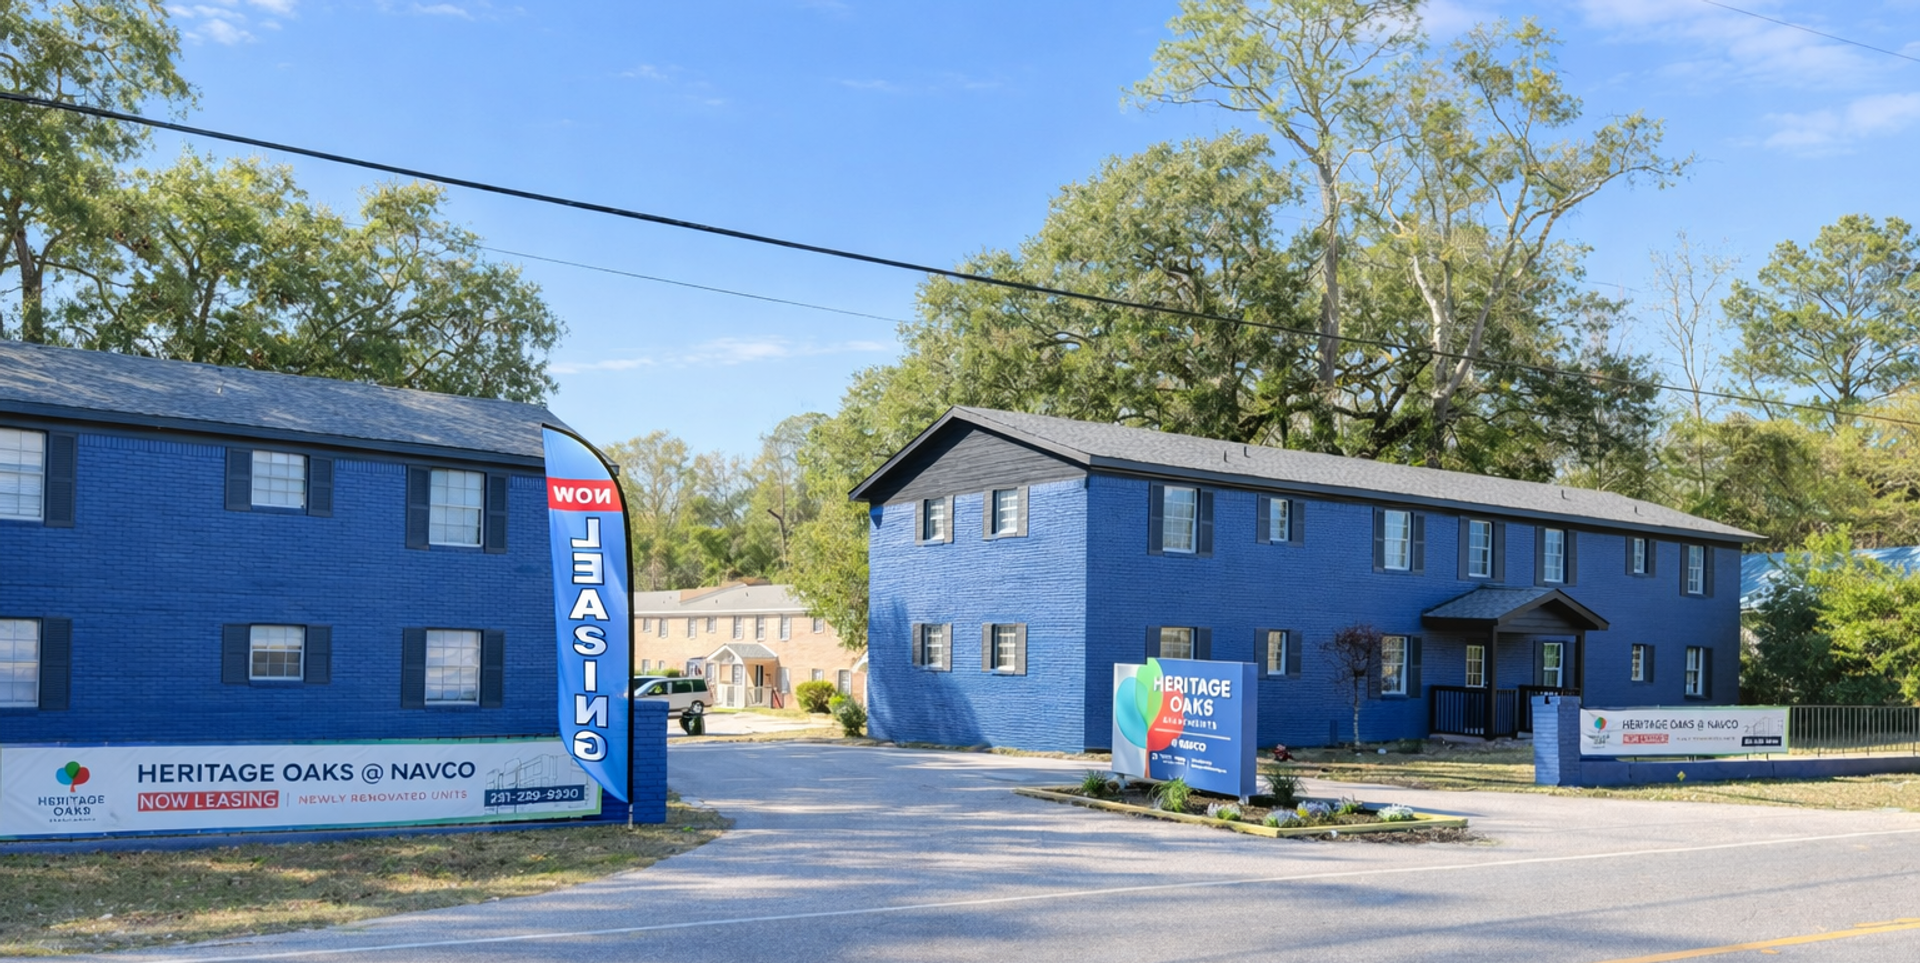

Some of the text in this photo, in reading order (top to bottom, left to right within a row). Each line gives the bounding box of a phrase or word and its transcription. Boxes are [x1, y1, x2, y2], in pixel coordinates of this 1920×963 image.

[1153, 675, 1231, 698] HERITAGE
[1169, 695, 1214, 717] OAKS
[138, 761, 476, 785] HERITAGE OAKS @ NAVCO
[139, 791, 277, 810] NOW LEASING
[298, 794, 347, 805] NEWLY
[431, 789, 468, 801] UNITS
